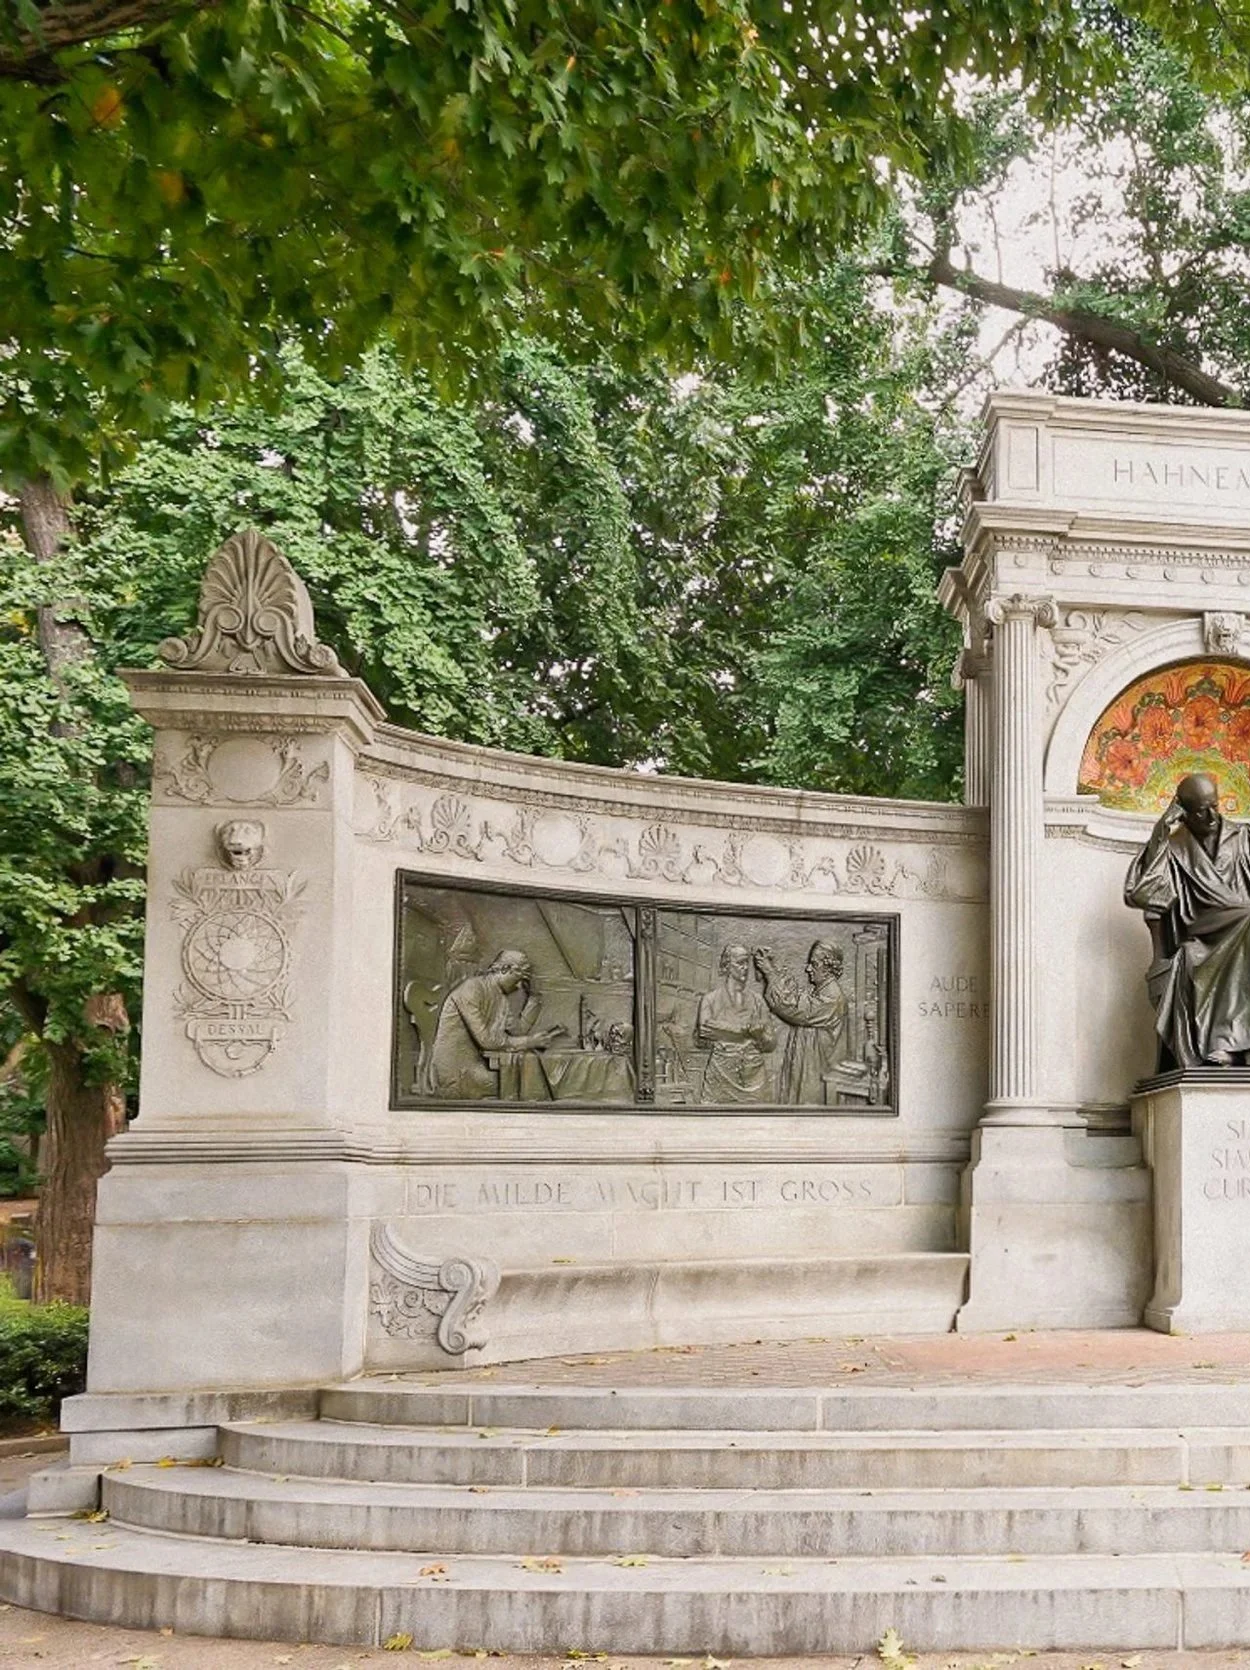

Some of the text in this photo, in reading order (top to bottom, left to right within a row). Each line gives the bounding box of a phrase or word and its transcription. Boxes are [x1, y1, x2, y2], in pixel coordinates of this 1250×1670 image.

[930, 975, 978, 993] AUDE
[918, 1001, 990, 1018] SAPERE
[416, 1183, 457, 1208] DIE
[477, 1182, 572, 1206] MILDE
[722, 1180, 758, 1202] IST
[780, 1179, 873, 1202] GROSS
